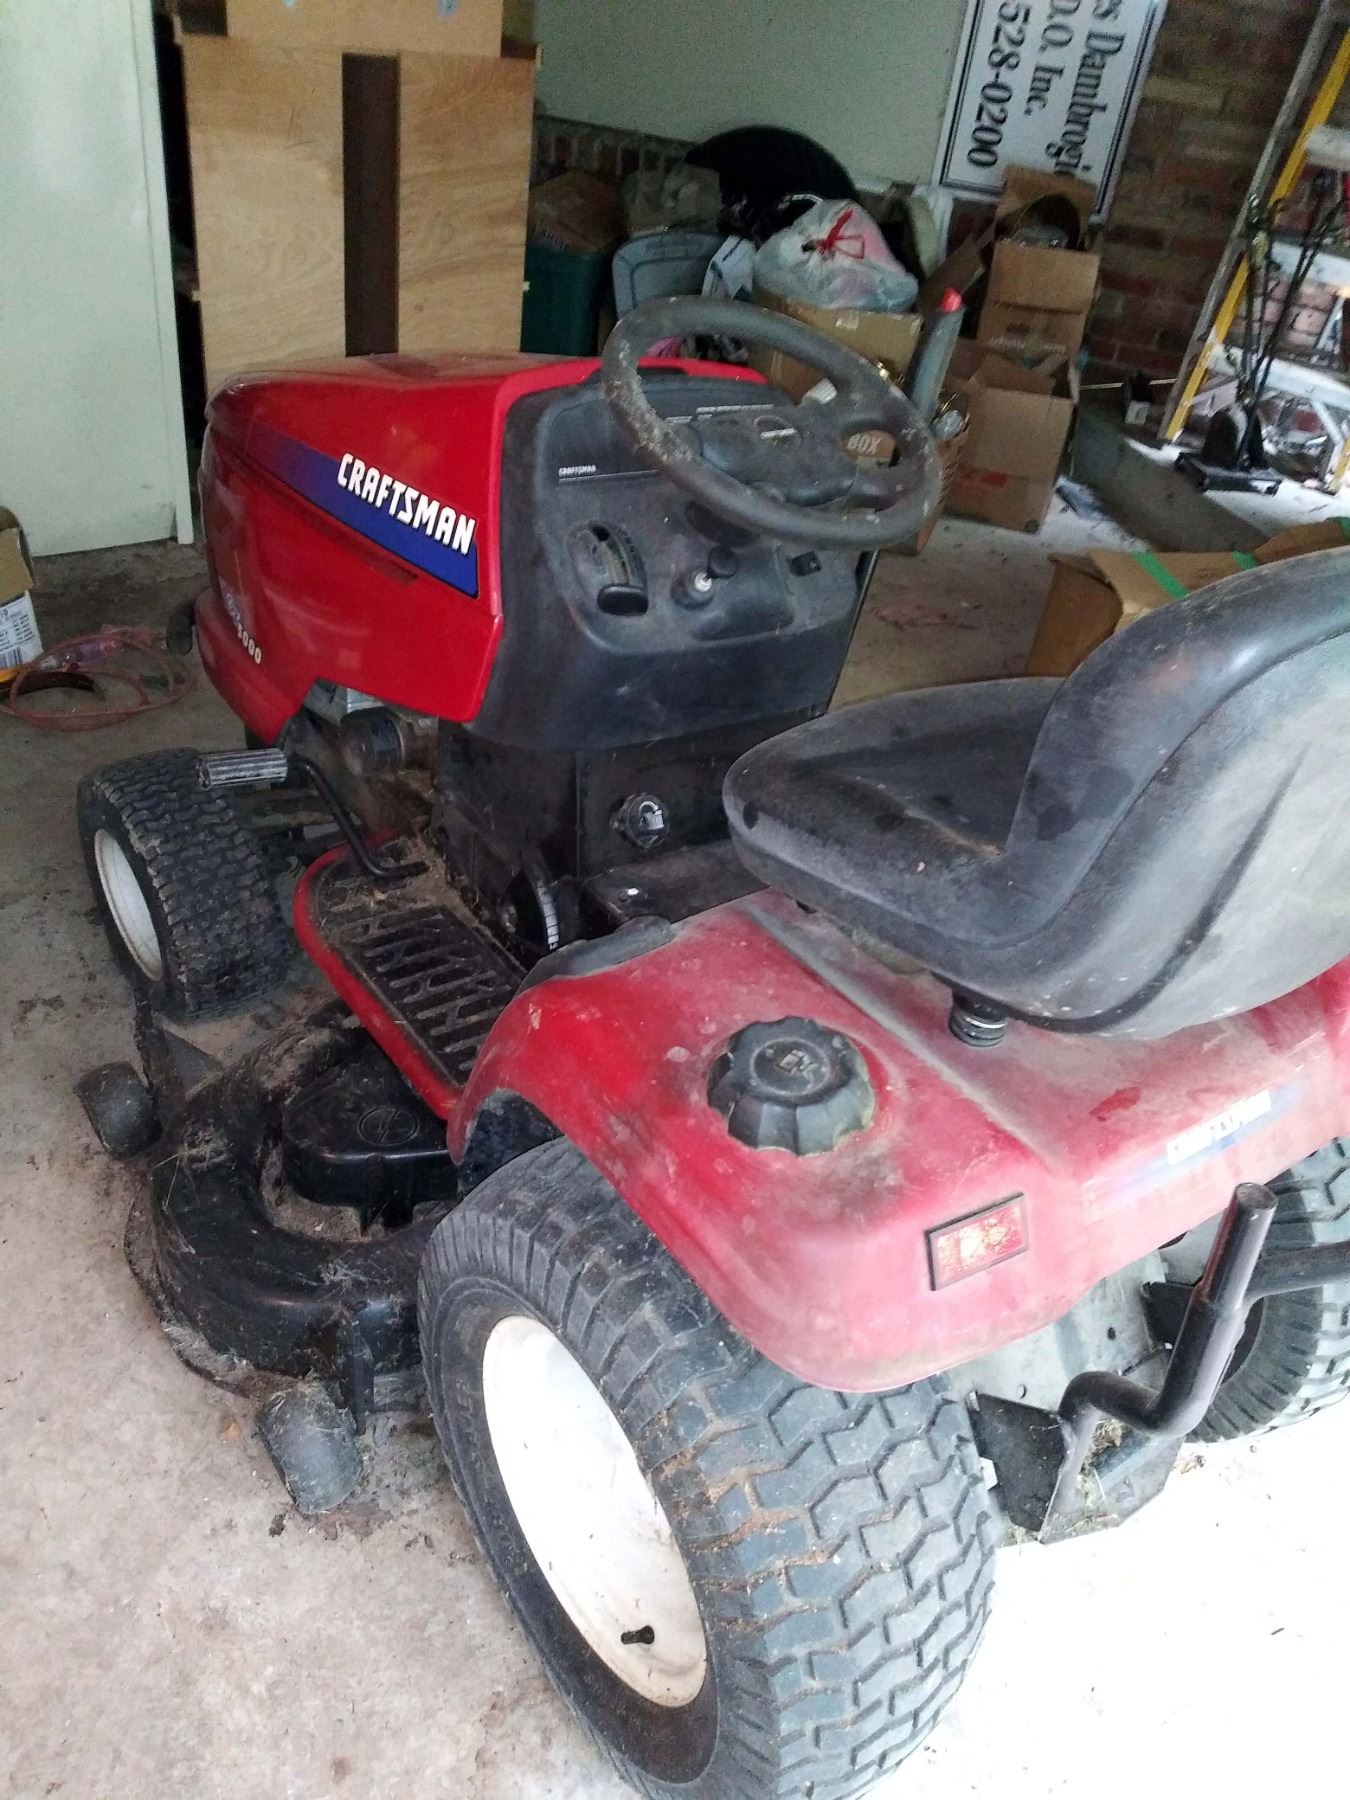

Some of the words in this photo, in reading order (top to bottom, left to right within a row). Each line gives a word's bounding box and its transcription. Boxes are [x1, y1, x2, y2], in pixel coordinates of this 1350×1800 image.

[966, 0, 1031, 168] 528-0200
[1024, 63, 1066, 116] Inc.
[1045, 30, 1126, 177] Dambrogi
[846, 432, 882, 456] BOX
[337, 452, 476, 556] CRAFTSMAN
